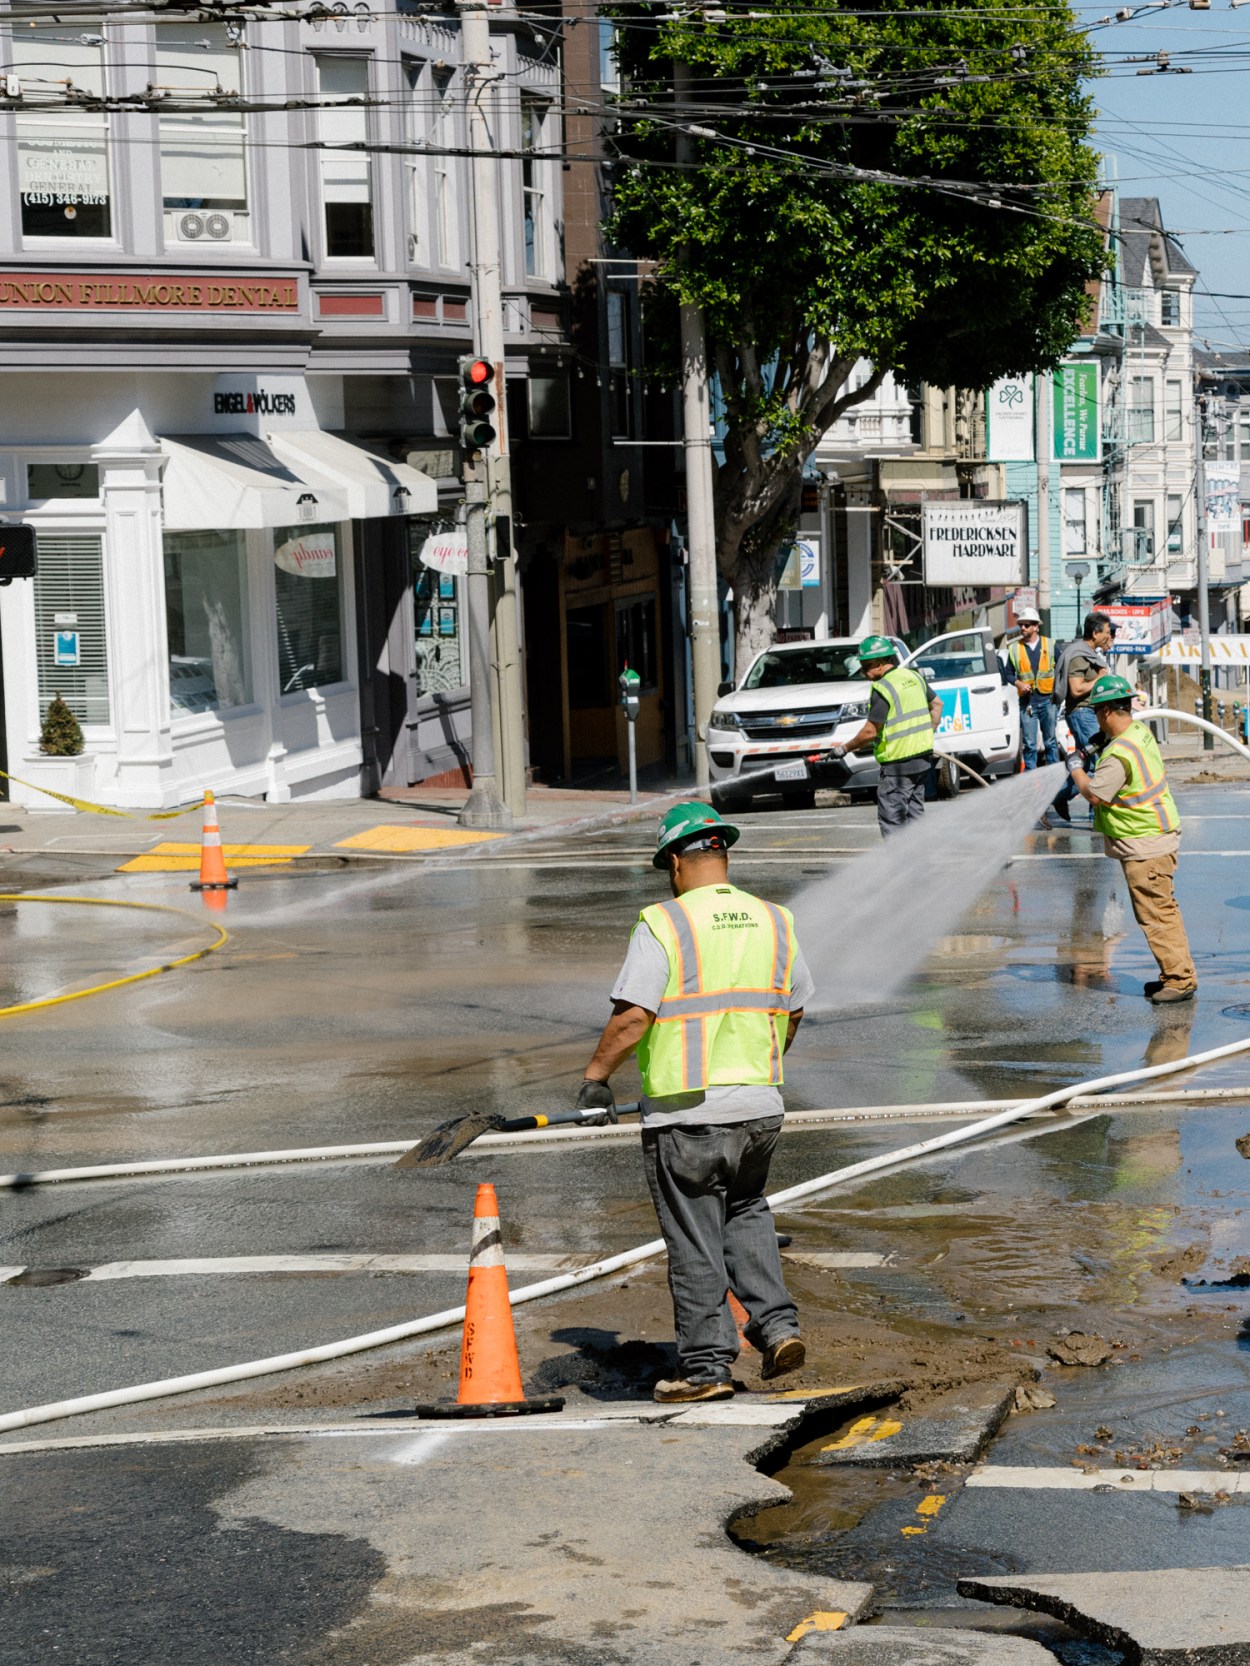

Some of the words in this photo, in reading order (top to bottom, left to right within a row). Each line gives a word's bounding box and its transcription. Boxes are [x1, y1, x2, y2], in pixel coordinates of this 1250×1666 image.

[24, 193, 54, 206] (415)
[56, 194, 107, 205] 346-9173
[0, 283, 73, 303] UNION
[79, 283, 203, 306] FILLMORE
[206, 286, 299, 307] DENTAL
[1063, 368, 1076, 456] EXCELLENCE
[1079, 409, 1088, 421] We
[1079, 423, 1088, 451] Pursue
[929, 527, 1017, 541] FREDERICKSEN
[953, 543, 1017, 557] HARDWARE
